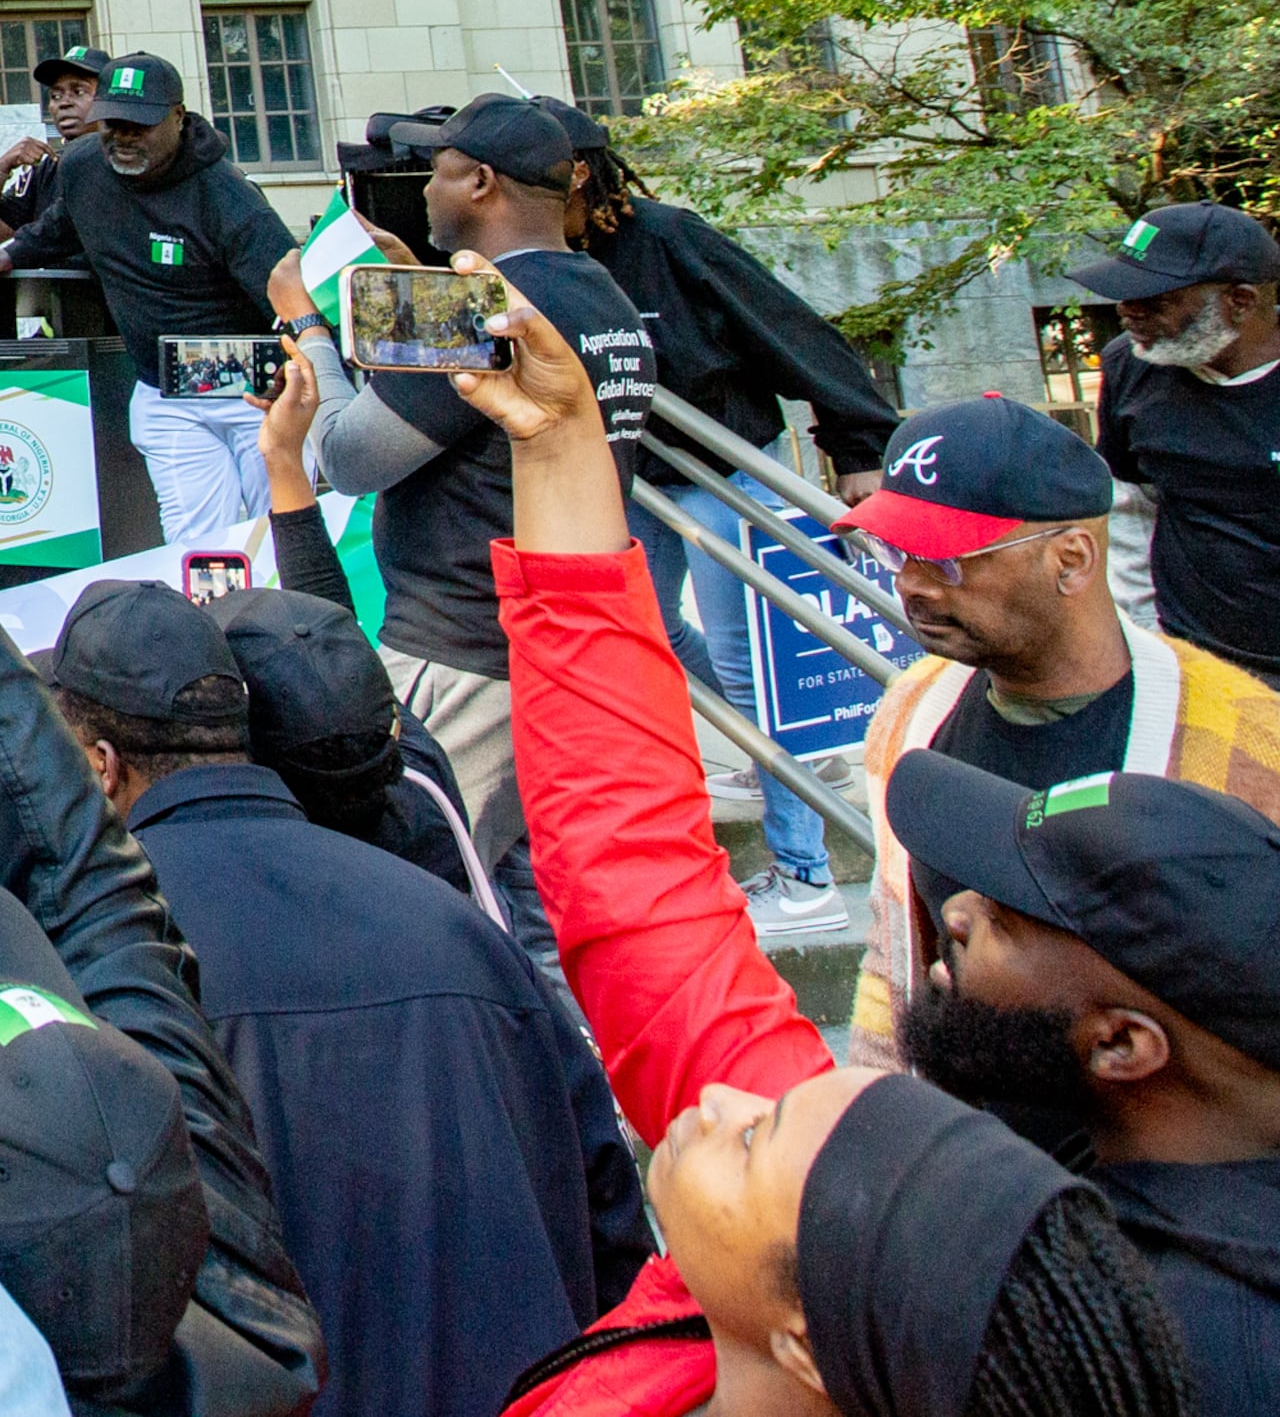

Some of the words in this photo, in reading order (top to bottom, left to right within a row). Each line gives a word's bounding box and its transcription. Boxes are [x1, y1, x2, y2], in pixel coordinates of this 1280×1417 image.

[580, 328, 640, 355] Appreciation
[609, 353, 622, 373] for
[623, 357, 640, 372] our
[597, 378, 625, 401] Global
[21, 431, 31, 440] OF
[31, 440, 49, 474] NIGERIA
[888, 435, 944, 484] A
[798, 676, 824, 690] FOR
[828, 666, 865, 684] STATE
[1025, 811, 1043, 829] 62
